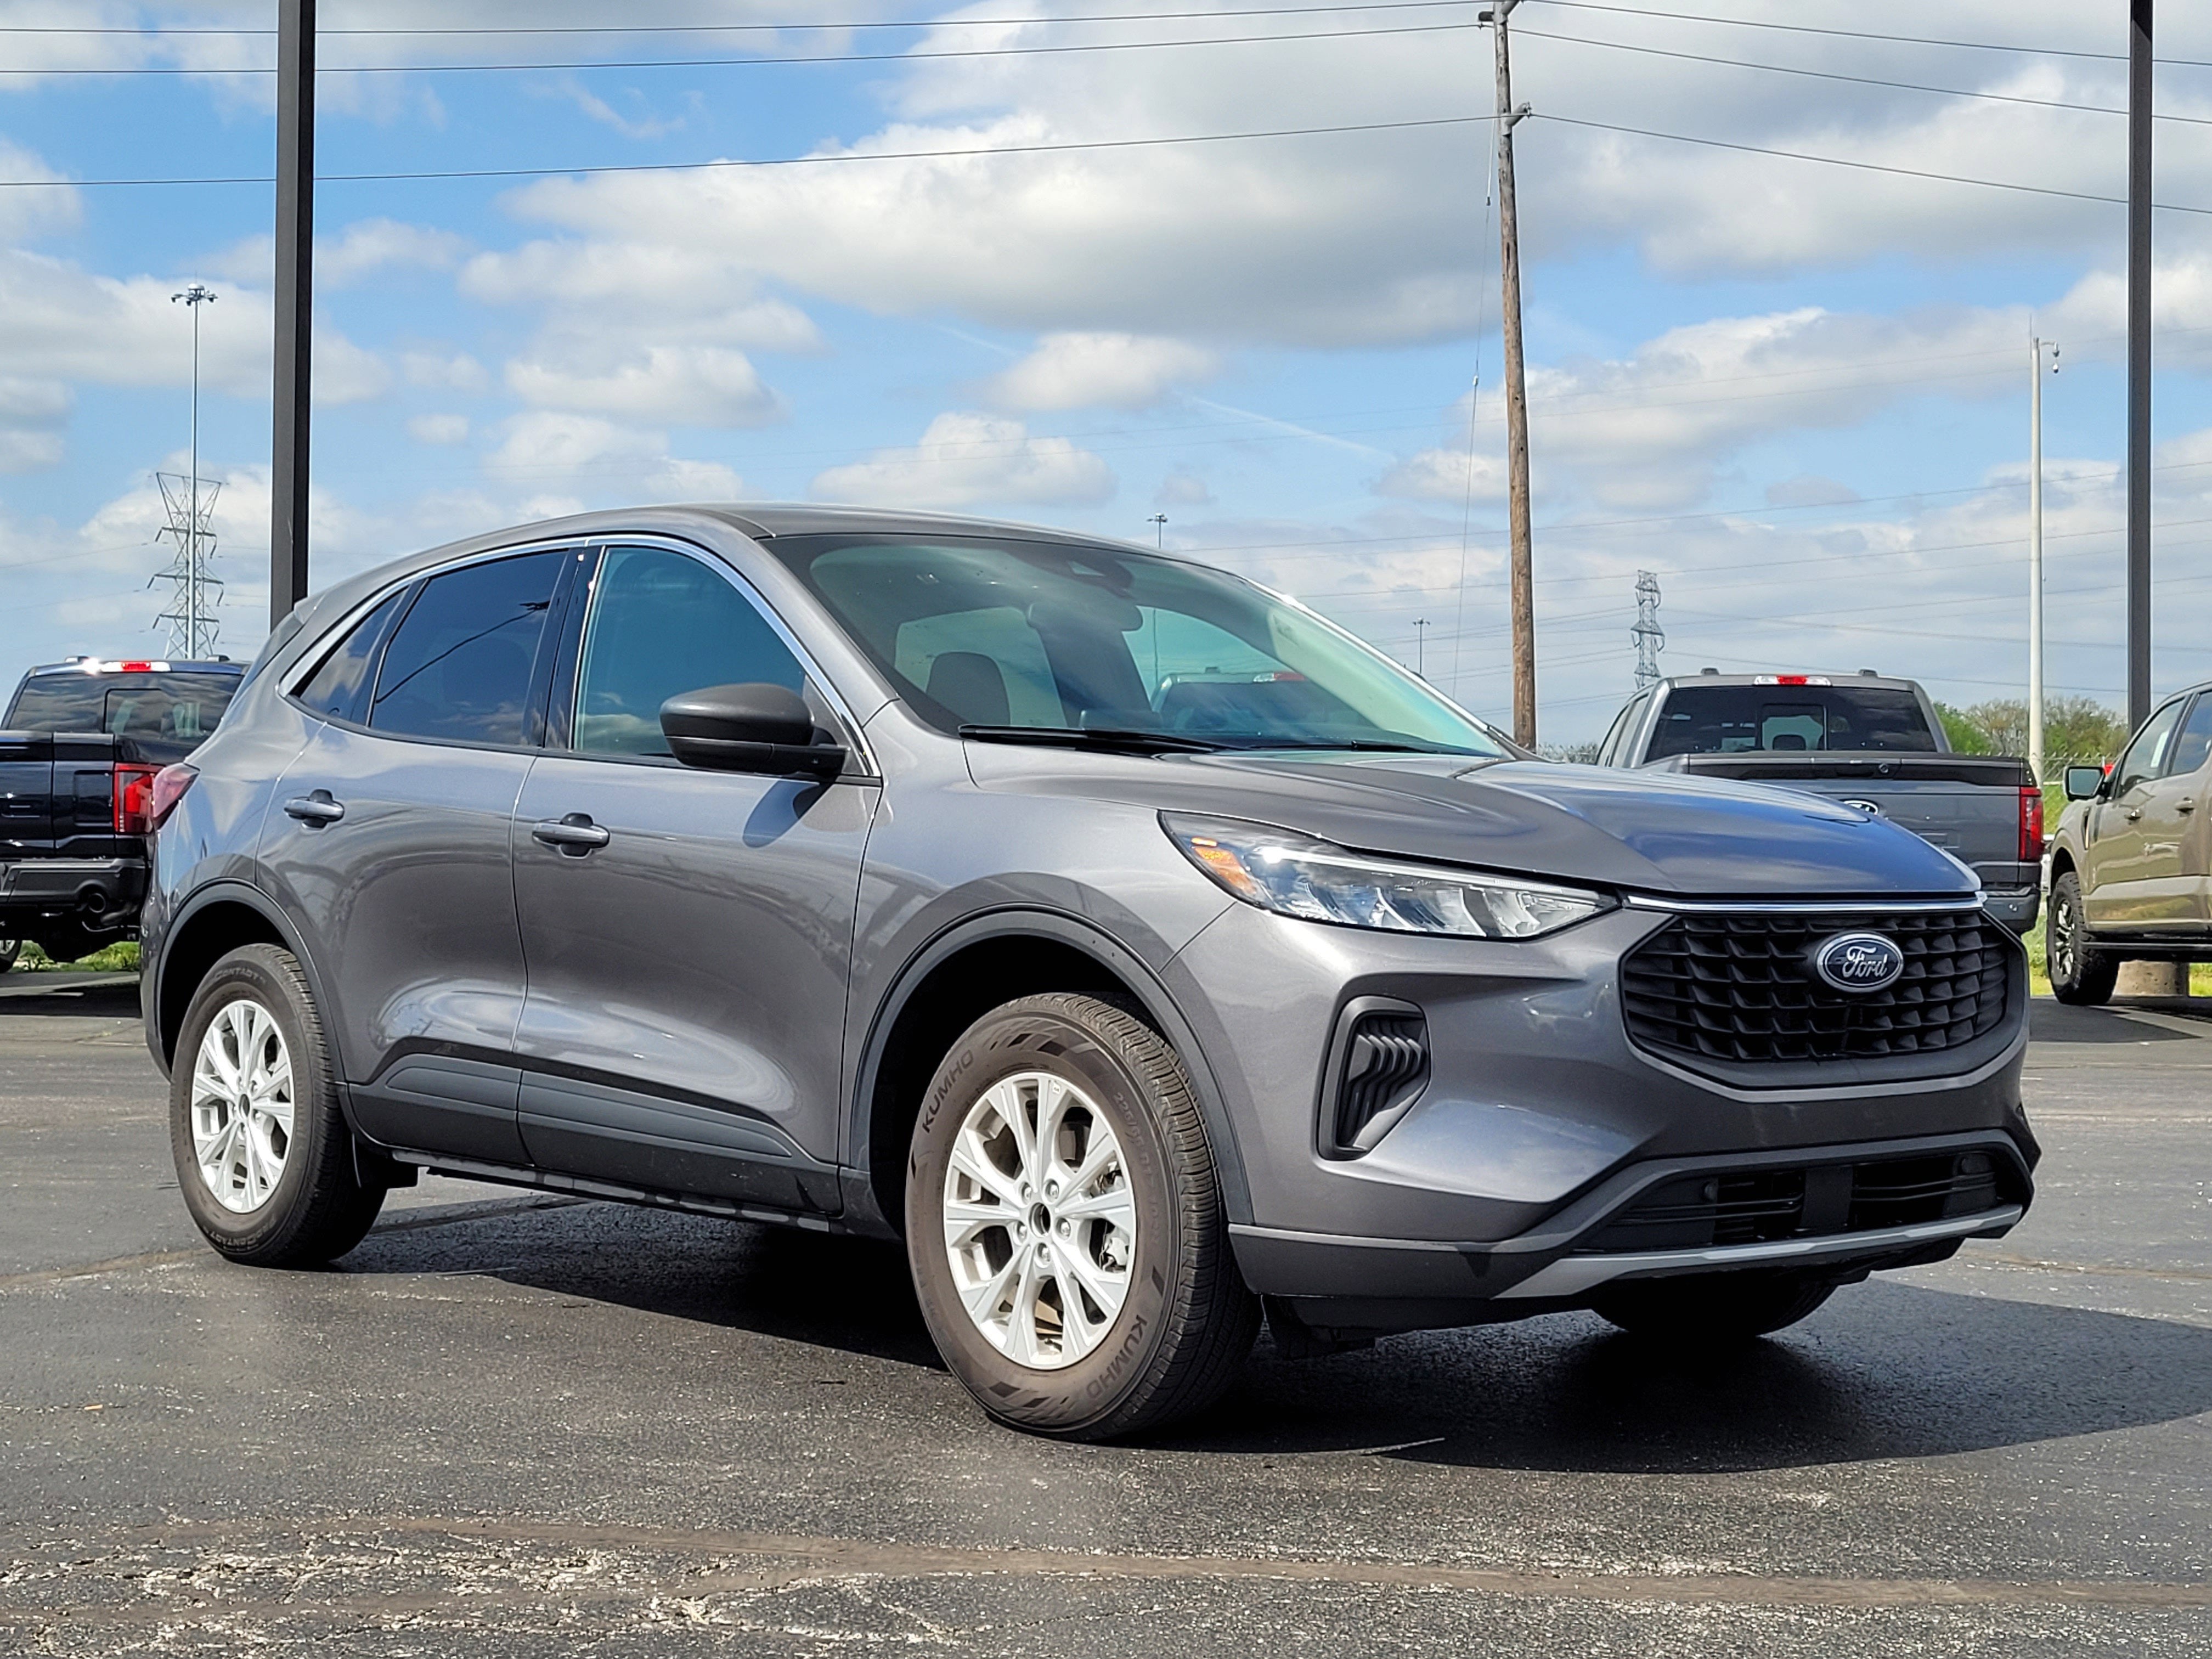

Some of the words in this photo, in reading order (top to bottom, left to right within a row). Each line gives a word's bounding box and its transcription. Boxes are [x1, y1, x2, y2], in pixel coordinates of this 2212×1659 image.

[1842, 946, 1888, 977] Ford
[922, 1049, 973, 1133] KUMHO
[1086, 1314, 1148, 1397] KUMHO
